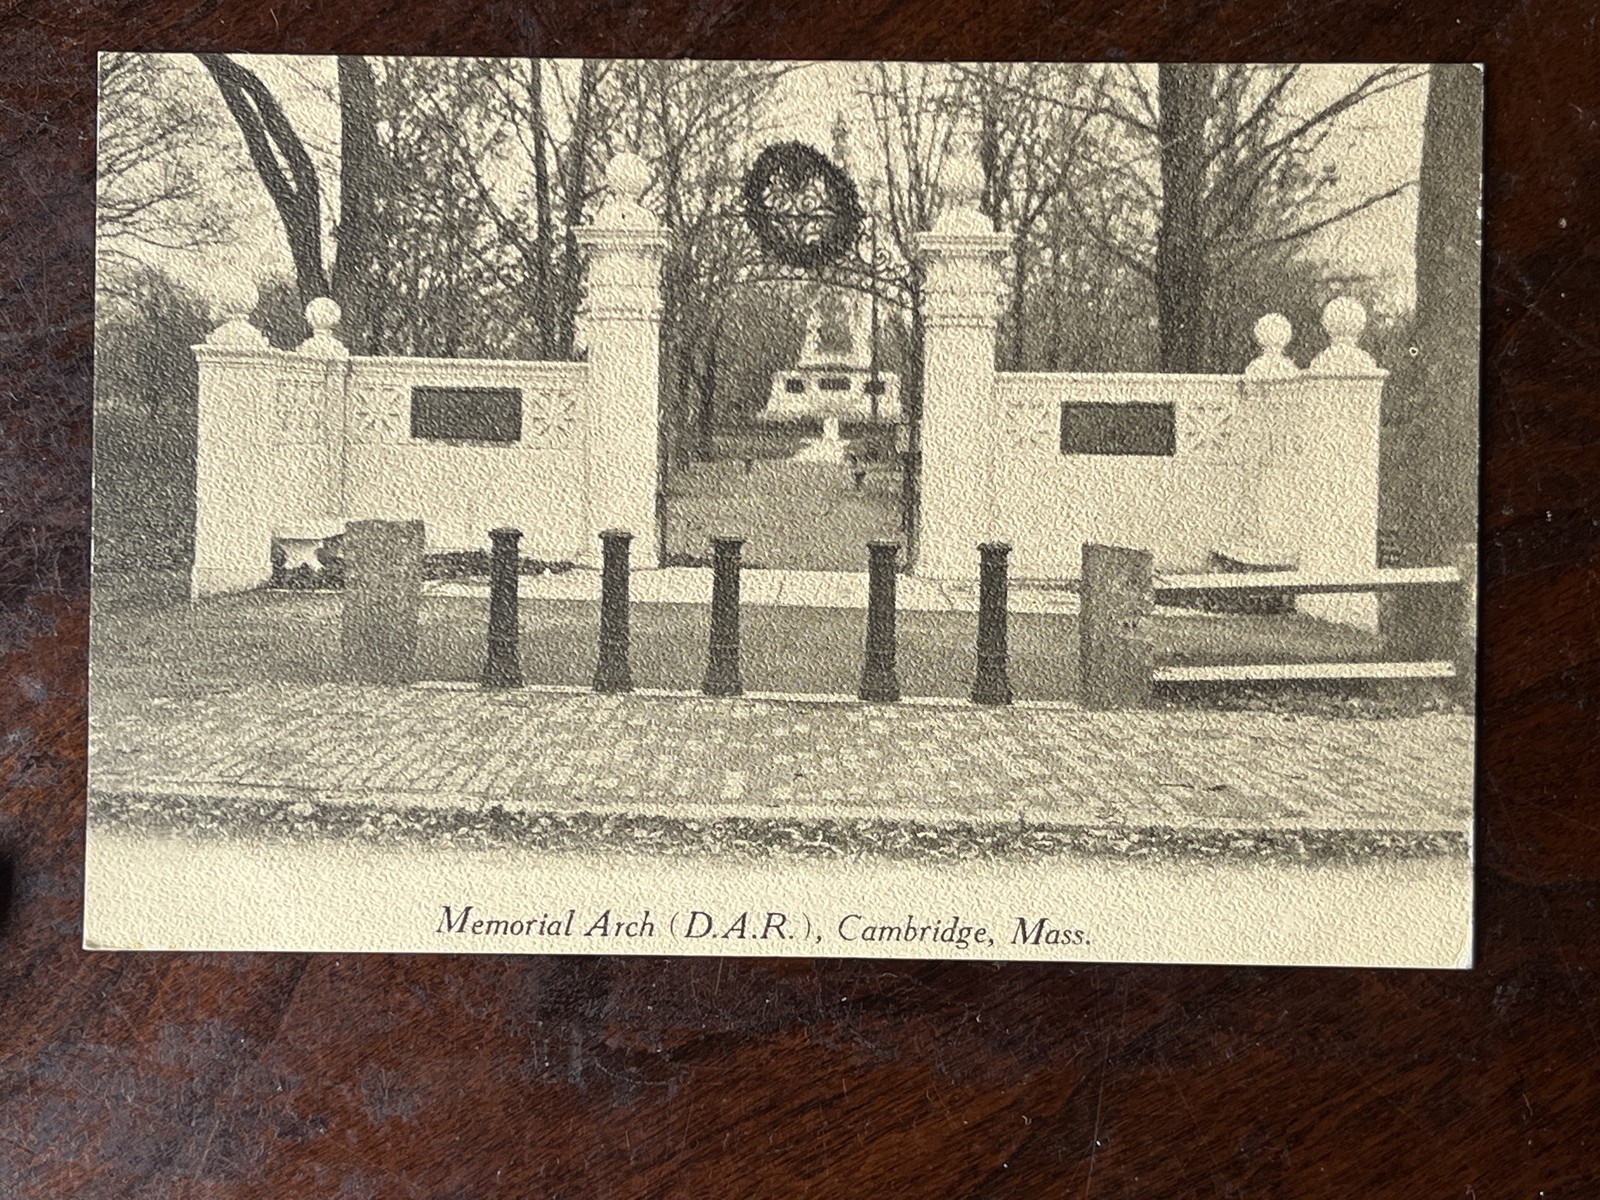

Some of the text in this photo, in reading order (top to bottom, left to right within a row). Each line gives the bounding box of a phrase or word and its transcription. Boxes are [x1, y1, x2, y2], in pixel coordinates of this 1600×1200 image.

[436, 905, 1092, 950] Memorial Arch (D.A.R.), Cambridge, Mass.
